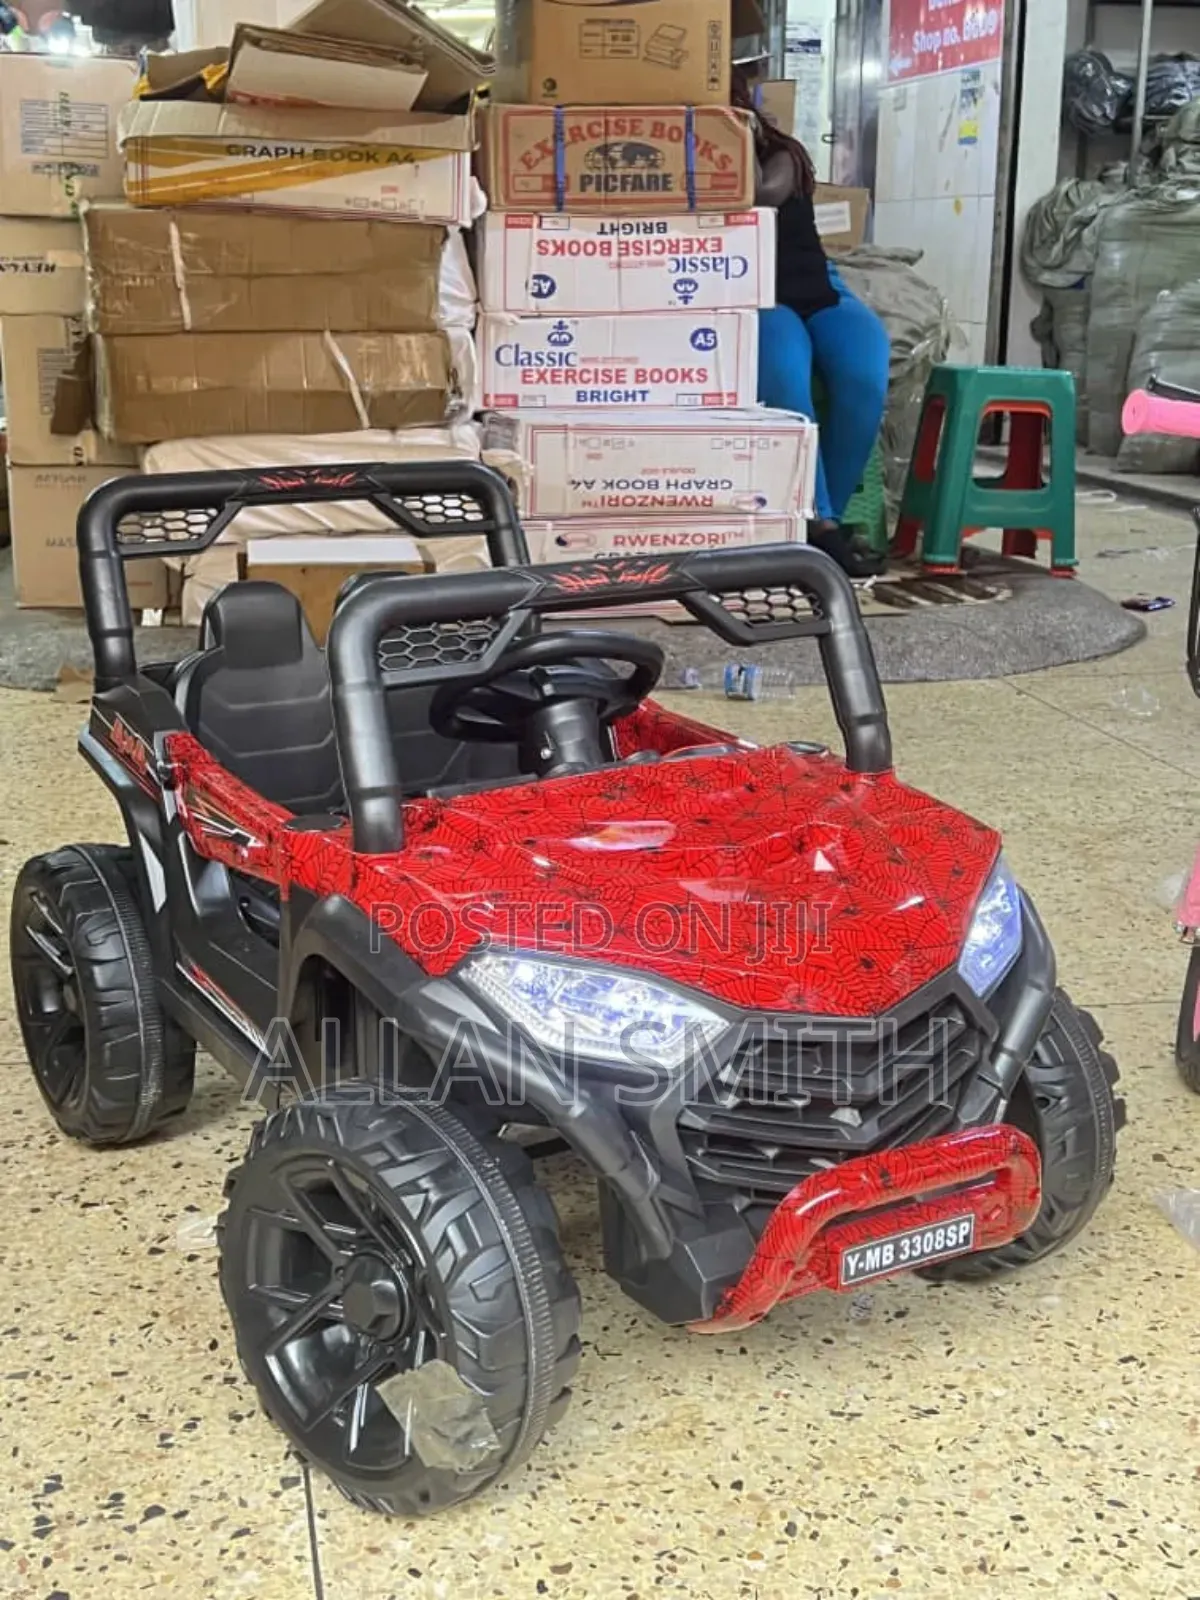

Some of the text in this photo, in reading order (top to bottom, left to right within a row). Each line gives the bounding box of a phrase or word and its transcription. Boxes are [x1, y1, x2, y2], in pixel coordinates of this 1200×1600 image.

[912, 30, 942, 54] Shop
[225, 144, 415, 164] GRAPH BOOK A4
[520, 118, 645, 171] EXRCISE
[580, 173, 673, 193] PICFARE
[597, 221, 668, 235] BRIGHT
[537, 237, 723, 256] EXERCISE BOOKS
[667, 255, 748, 280] Classic
[695, 333, 715, 347] A5
[495, 343, 578, 367] Classic
[521, 368, 708, 385] EXERCISE BOOKS
[576, 389, 650, 403] BRIGHT
[568, 479, 733, 491] GRAPH BOOK A4
[847, 1222, 970, 1276] Y-MB 3308SP
